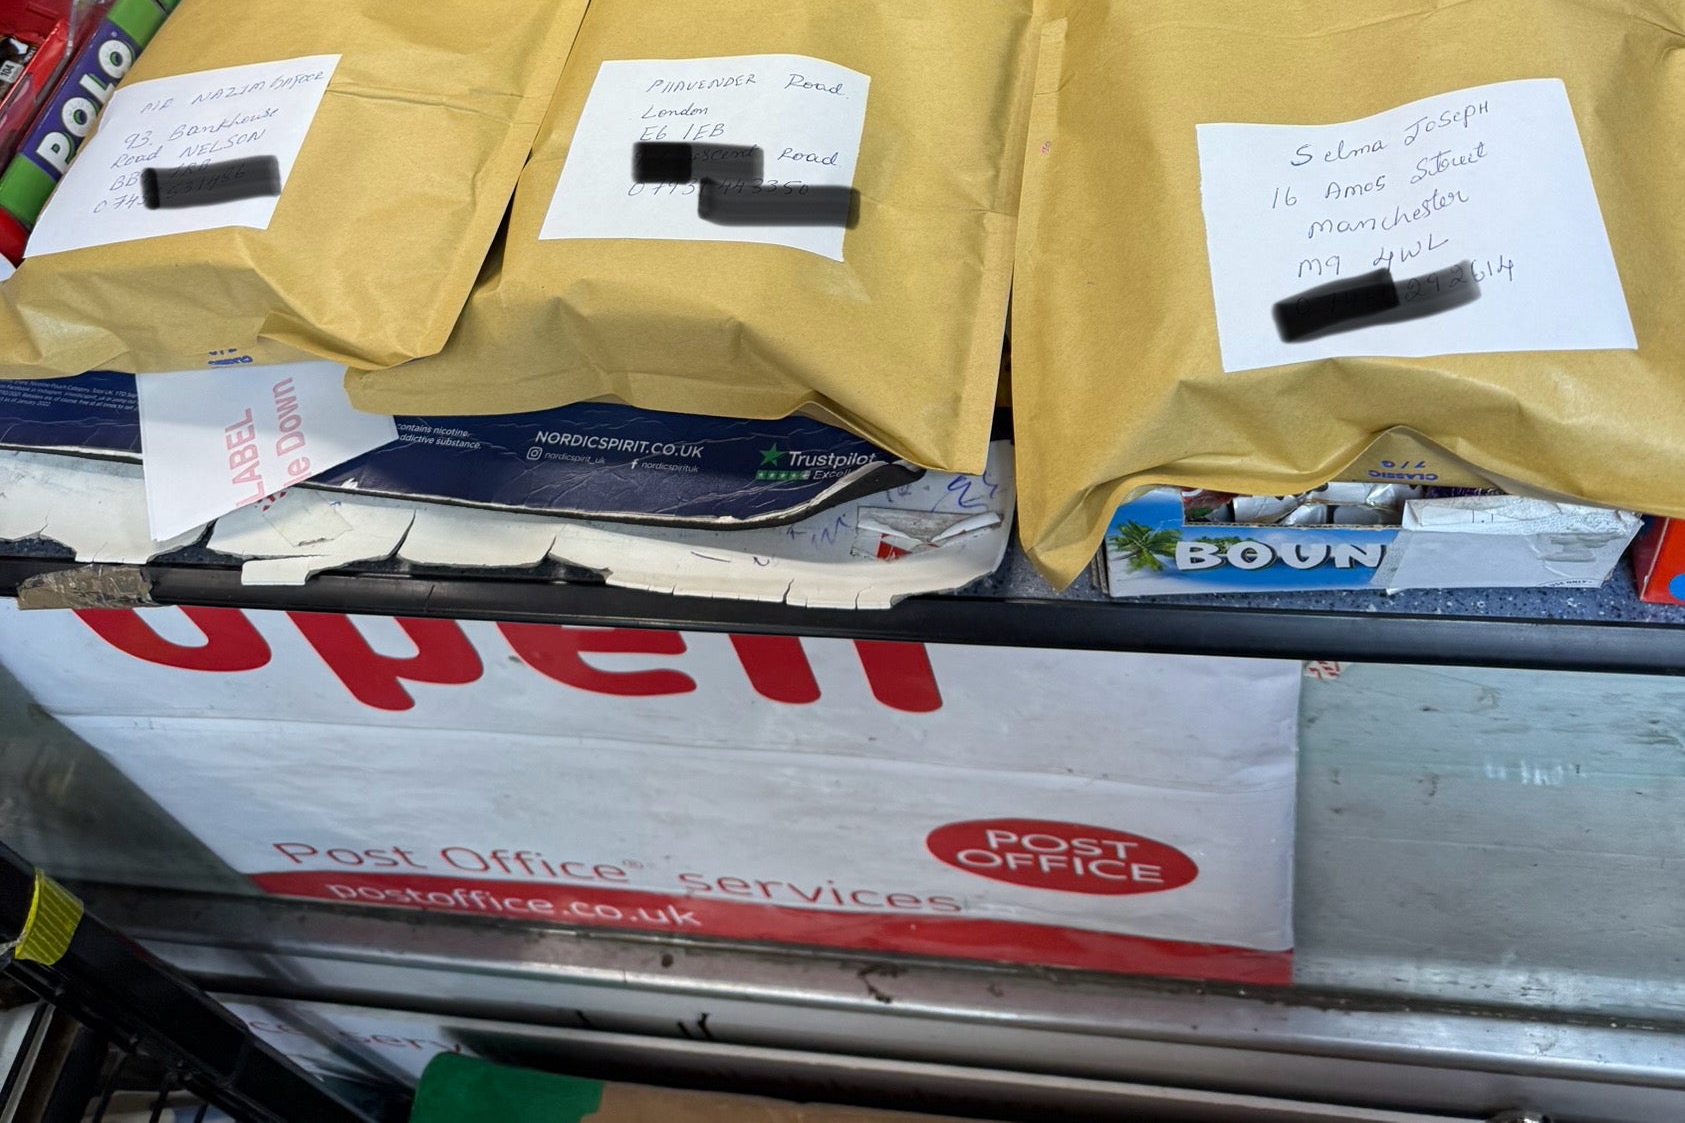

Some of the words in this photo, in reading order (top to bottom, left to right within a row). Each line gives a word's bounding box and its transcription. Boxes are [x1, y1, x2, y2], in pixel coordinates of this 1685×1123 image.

[36, 38, 136, 165] POLO
[640, 102, 710, 120] London
[179, 129, 266, 157] NELSON
[639, 125, 668, 142] E6
[1271, 186, 1299, 210] 16
[272, 377, 307, 456] Down
[398, 433, 436, 446] ddictive
[534, 430, 704, 458] NORDICSPIRIT.CO.UK
[225, 408, 266, 507] LABEL
[788, 450, 876, 470] Trustpilot
[1367, 469, 1438, 482] CLASSIC
[1175, 540, 1387, 571] BOUN
[984, 828, 1138, 859] POST
[272, 842, 429, 871] Post
[677, 869, 963, 914] services
[957, 849, 1164, 885] OFFICE
[325, 883, 701, 927] postoffice.co.uk
